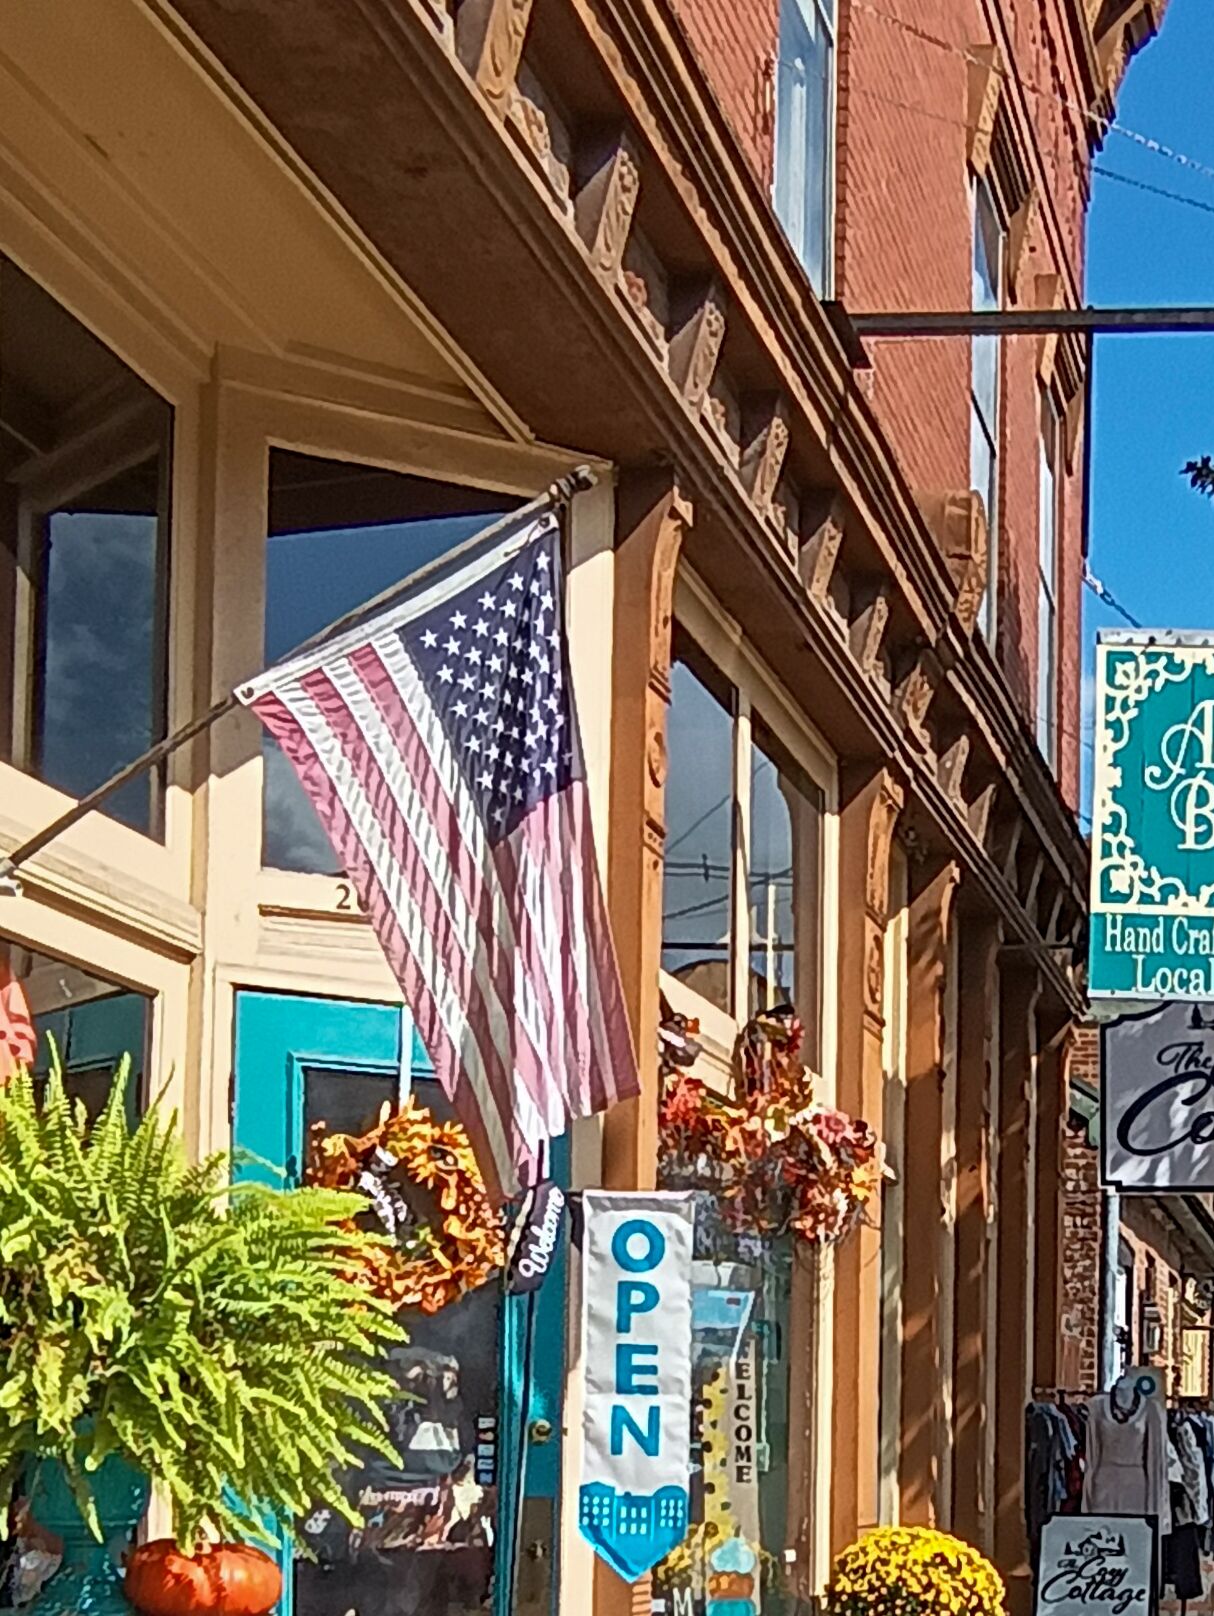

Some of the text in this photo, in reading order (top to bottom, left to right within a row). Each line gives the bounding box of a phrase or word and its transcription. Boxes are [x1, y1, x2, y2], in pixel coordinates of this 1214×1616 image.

[1104, 912, 1164, 953] Hand
[1156, 1040, 1213, 1073] The
[610, 1219, 666, 1457] OPEN
[1041, 1569, 1147, 1615] Cottage
